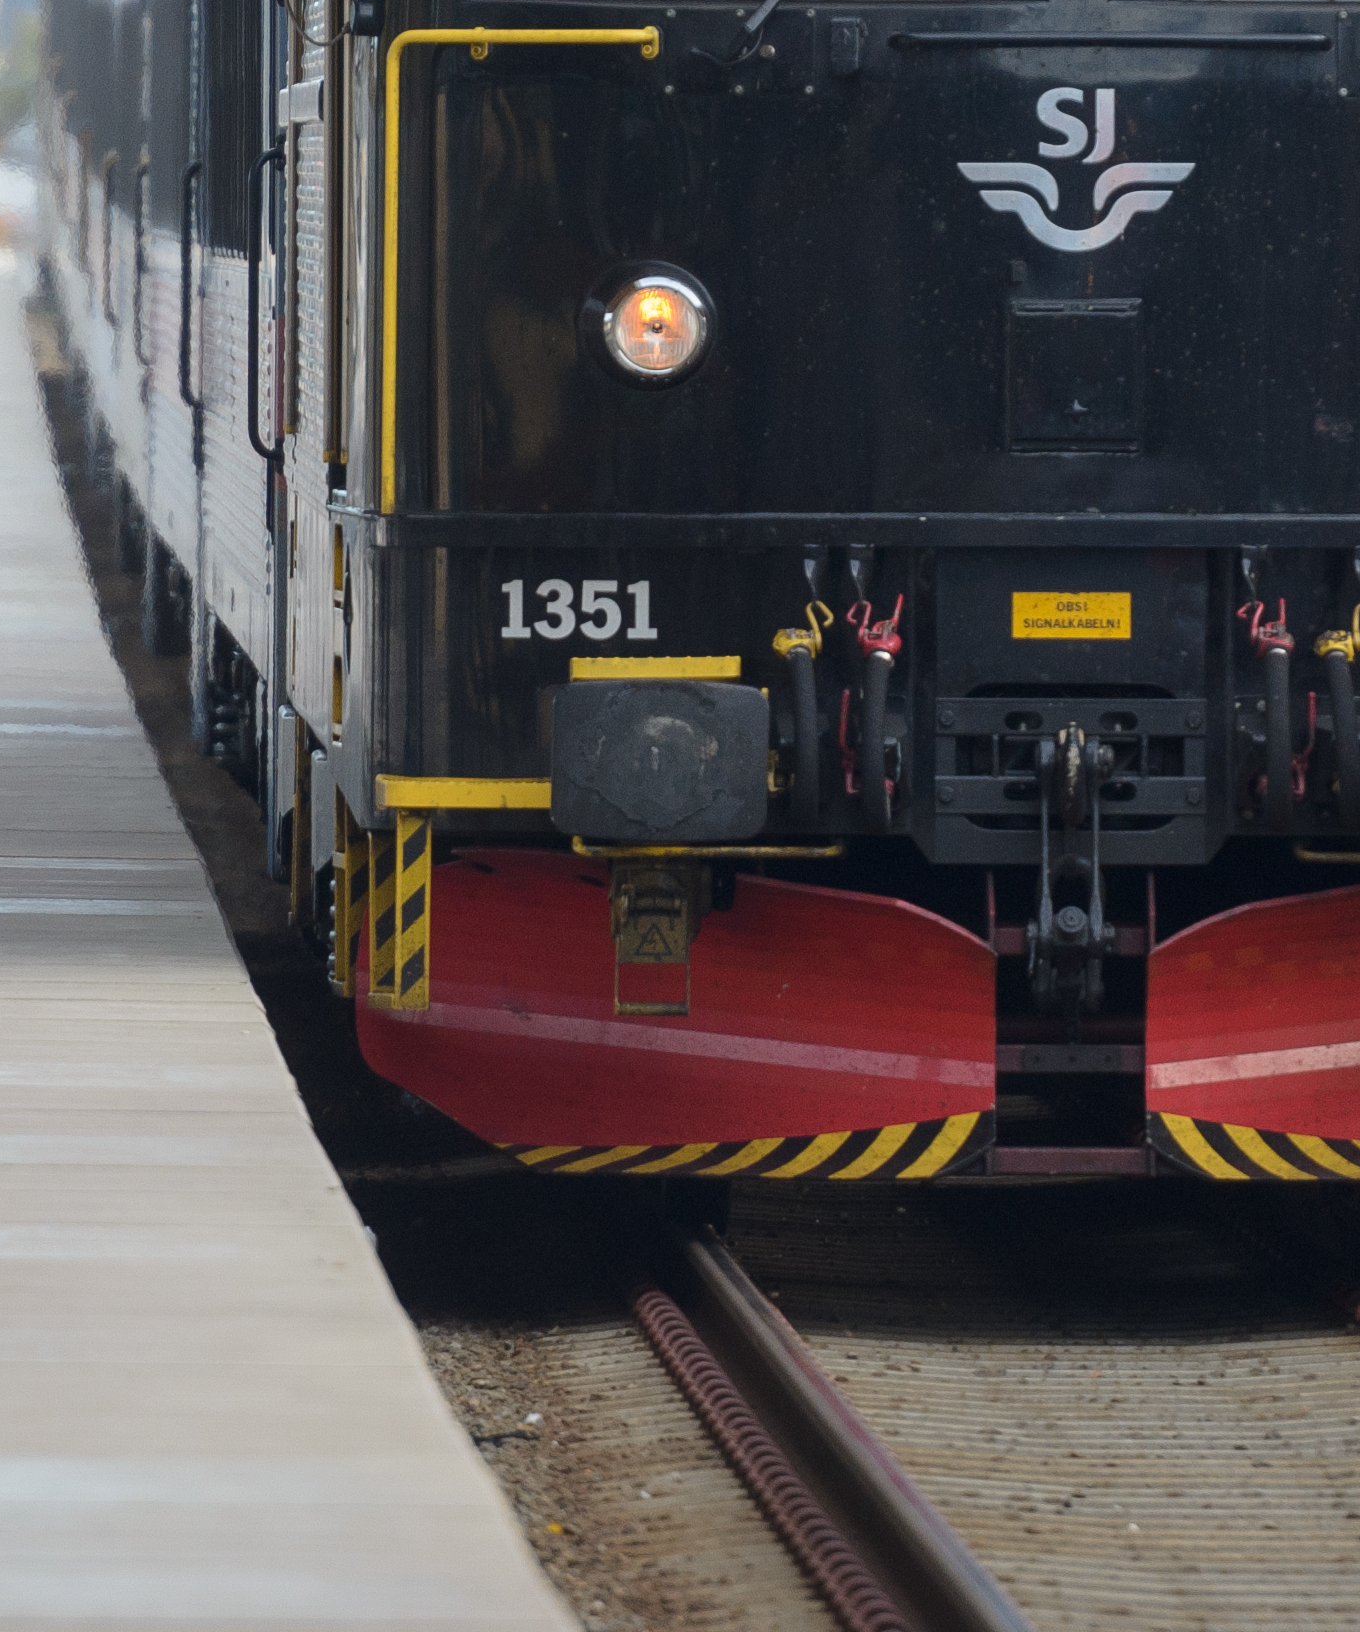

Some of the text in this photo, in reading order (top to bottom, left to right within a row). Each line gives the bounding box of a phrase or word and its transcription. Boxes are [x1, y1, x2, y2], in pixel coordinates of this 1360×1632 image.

[1035, 87, 1115, 164] SJ
[500, 579, 658, 640] 1351
[1023, 618, 1121, 628] SIGNALKABELN!
[1056, 601, 1088, 612] OBS!
